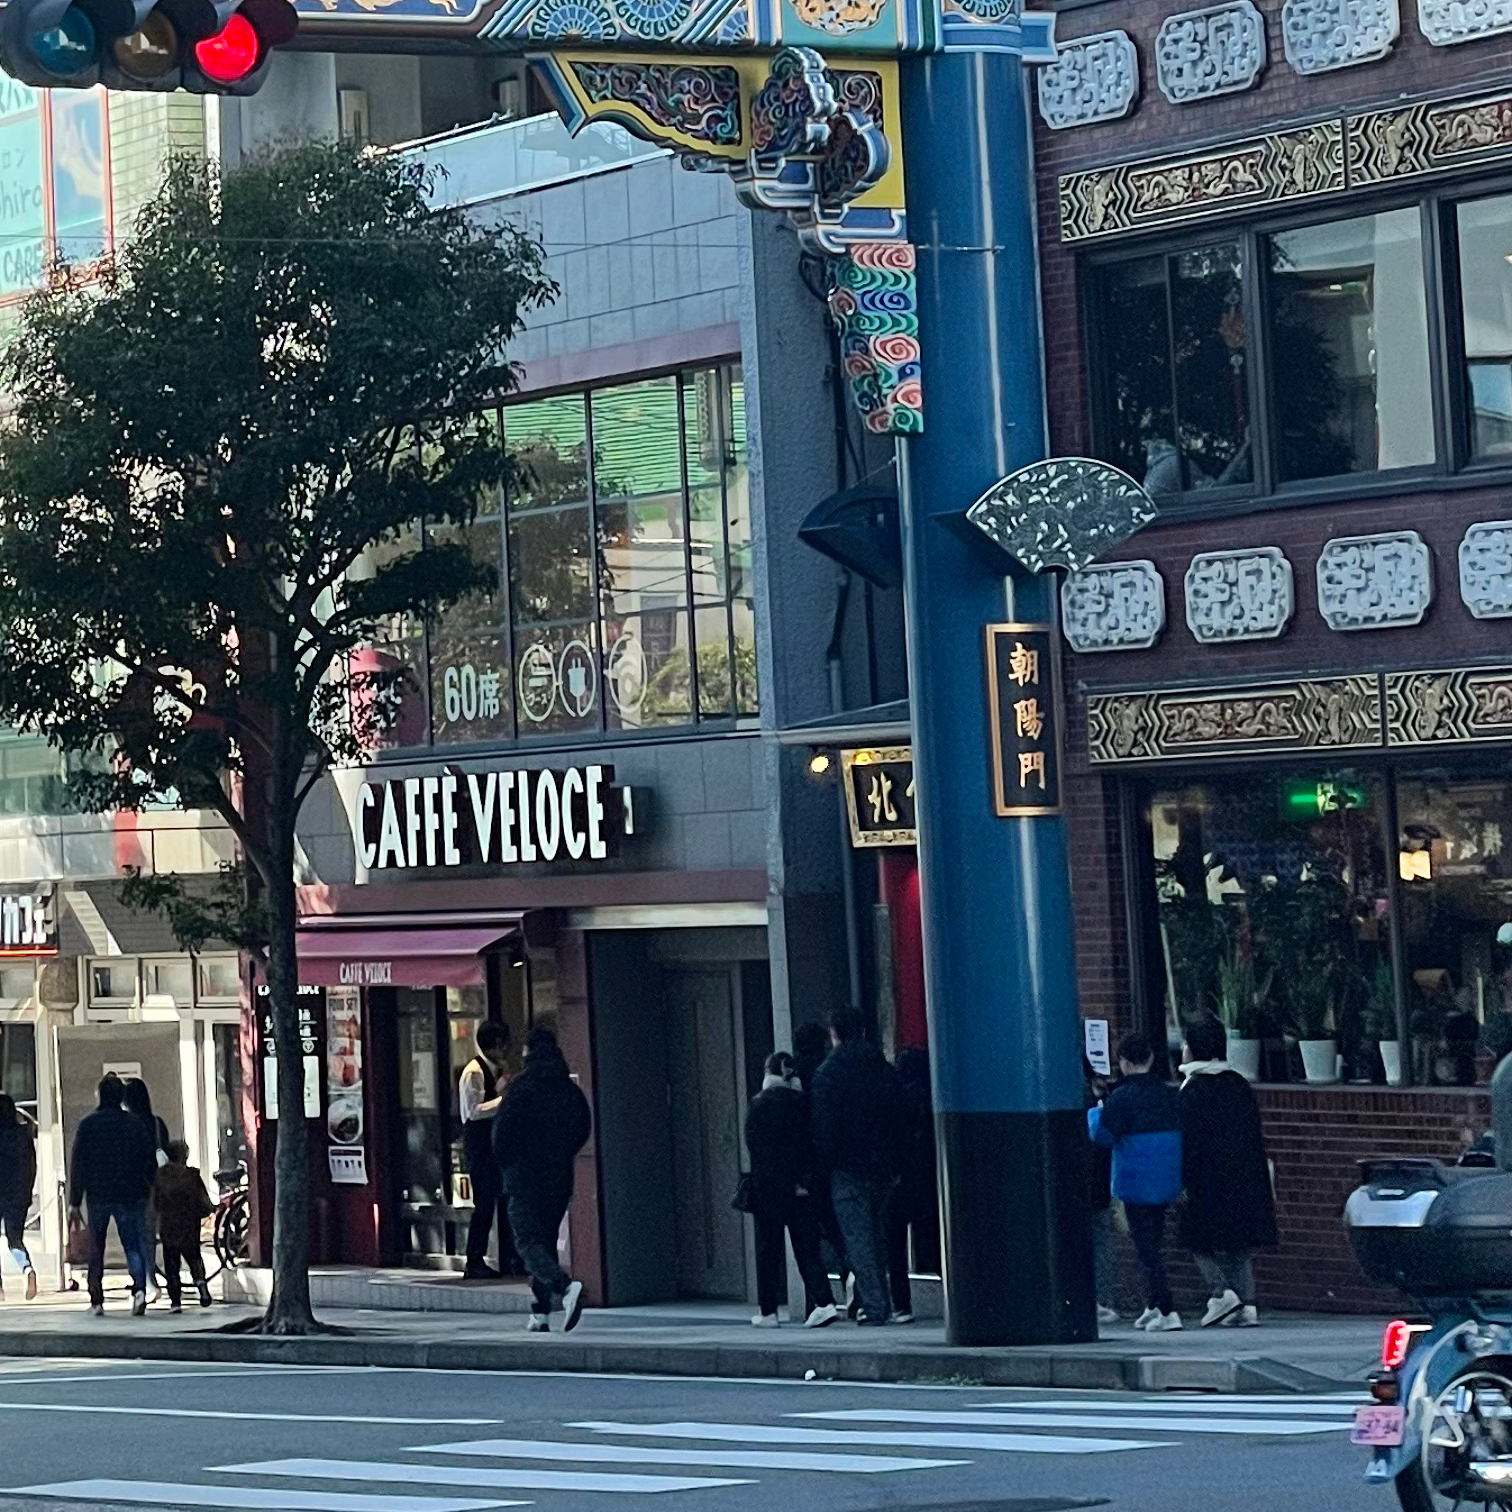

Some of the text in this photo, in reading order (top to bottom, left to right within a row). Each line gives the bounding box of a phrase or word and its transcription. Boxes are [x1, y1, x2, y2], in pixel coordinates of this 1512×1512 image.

[445, 663, 500, 722] 60席
[1008, 642, 1047, 792] 朝陽門
[355, 764, 607, 870] CAFFÈ VELOCE
